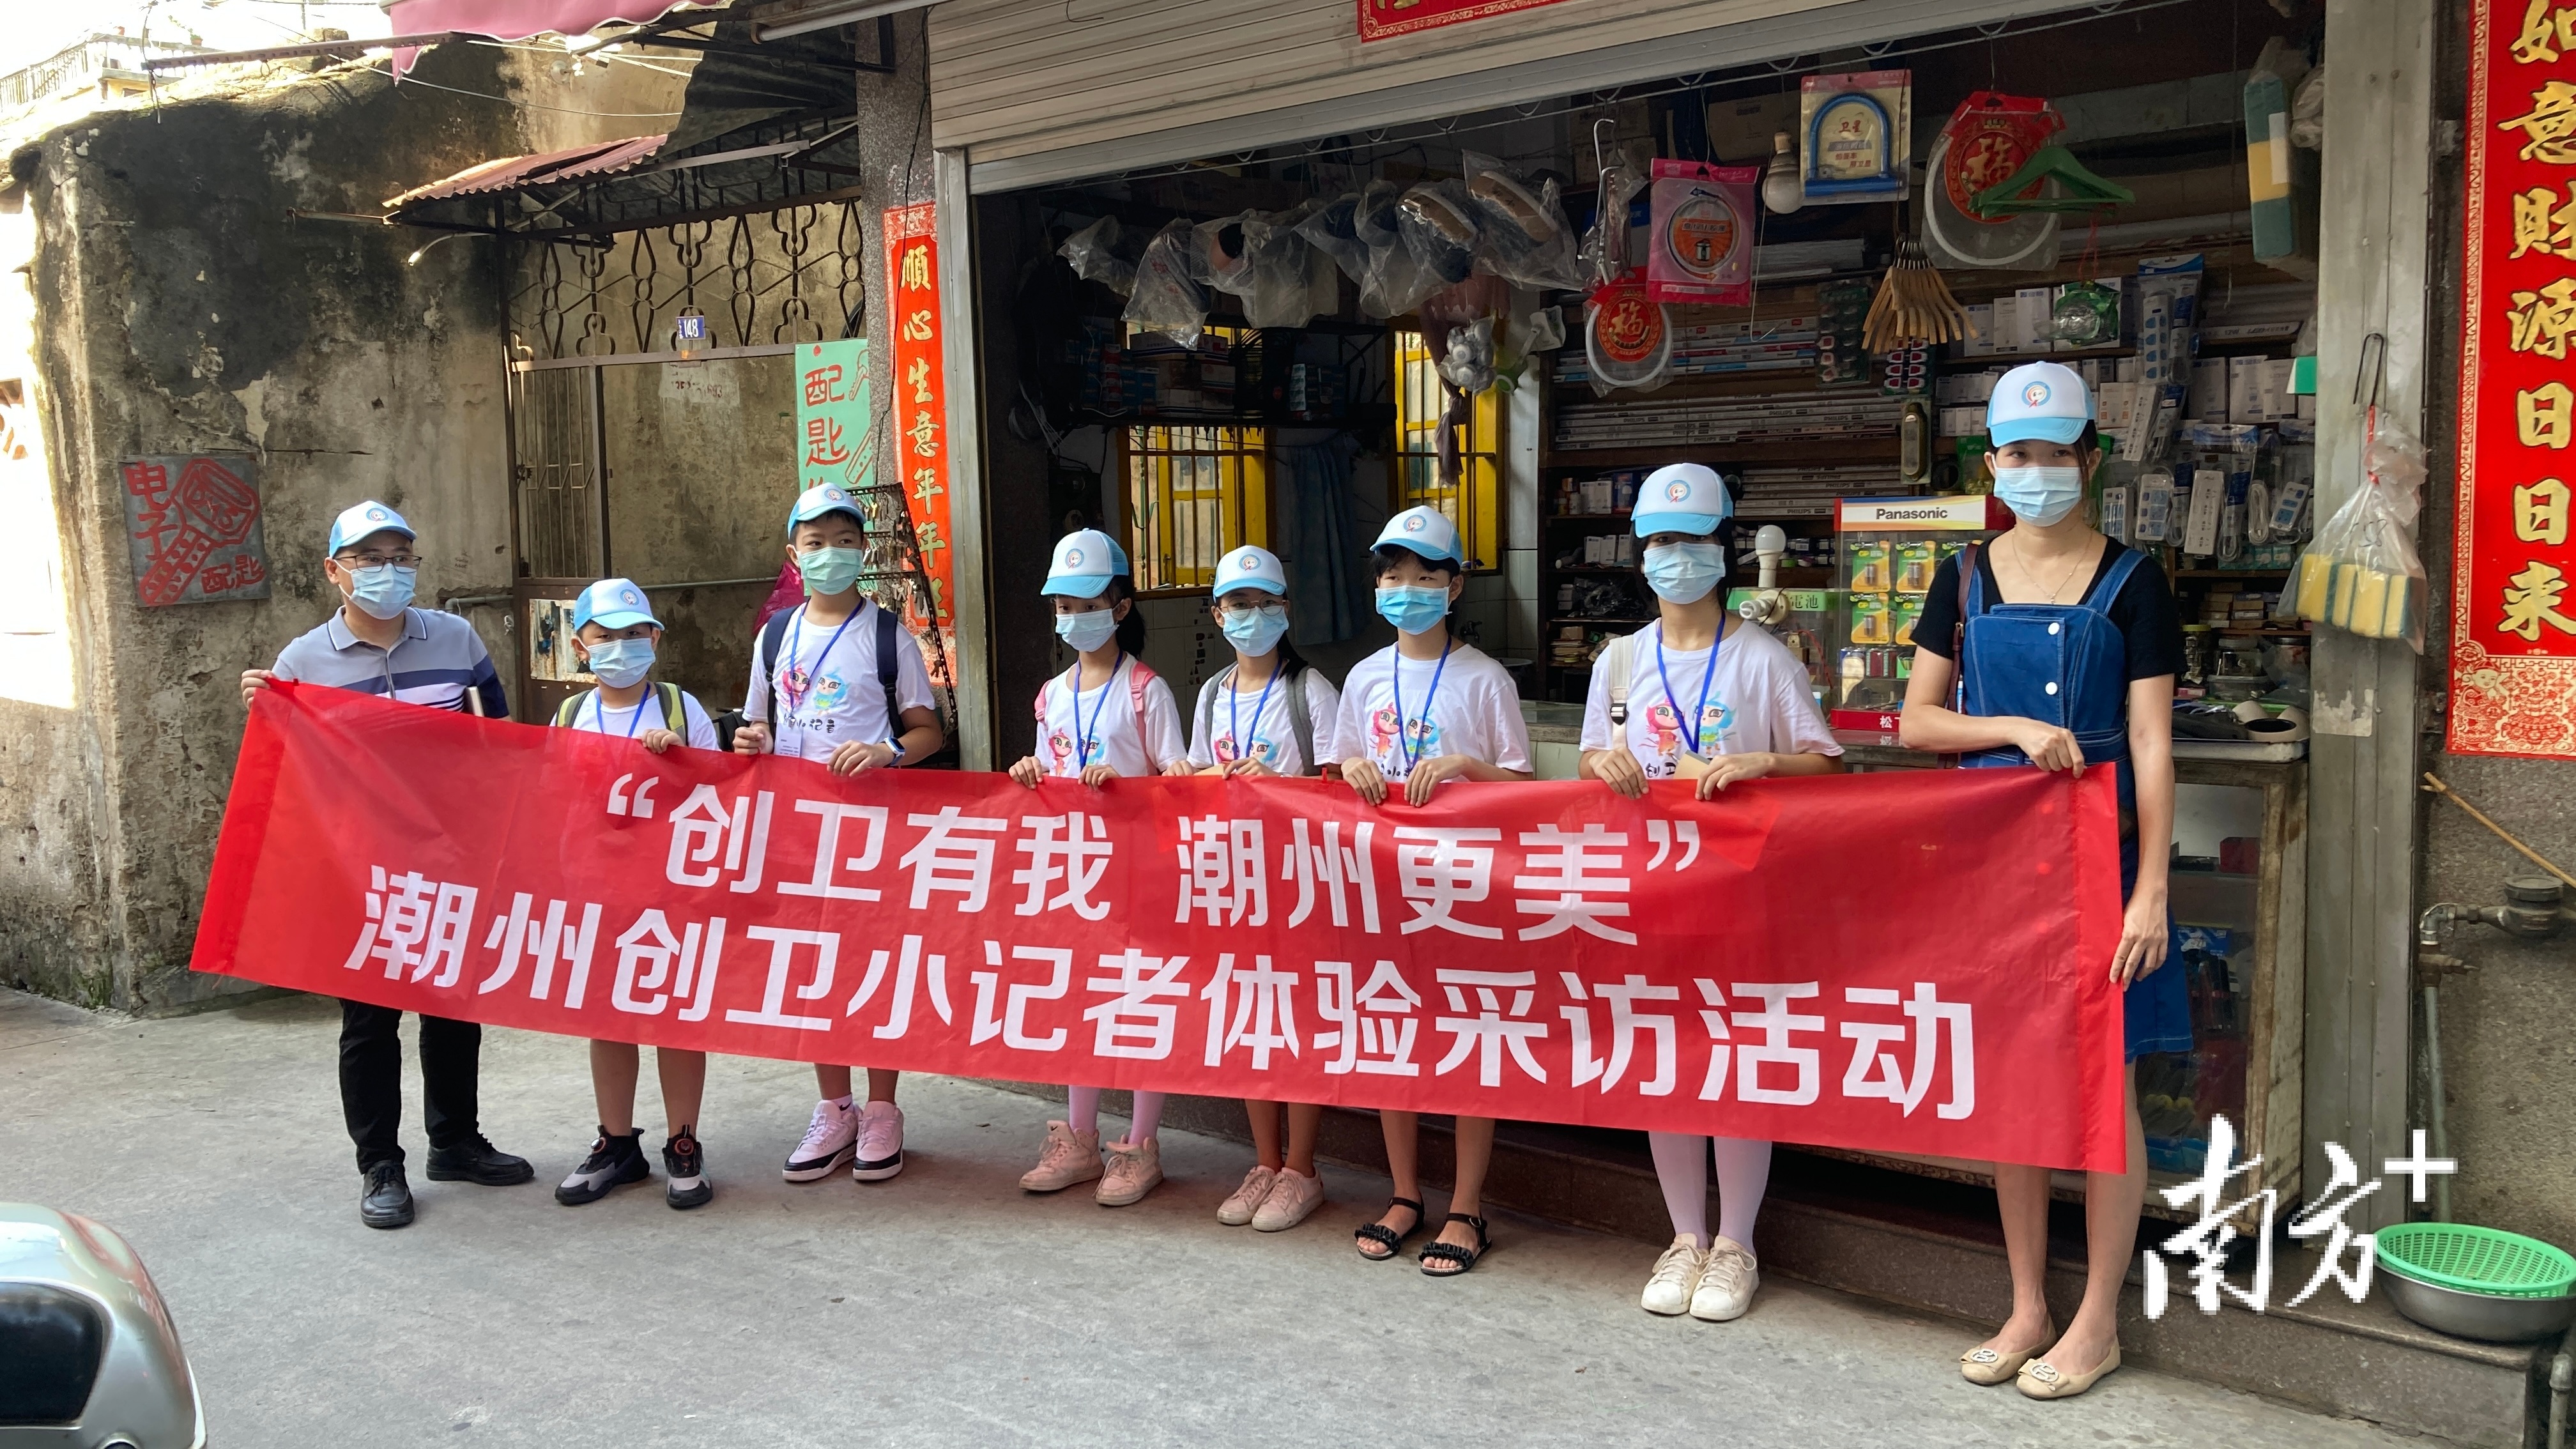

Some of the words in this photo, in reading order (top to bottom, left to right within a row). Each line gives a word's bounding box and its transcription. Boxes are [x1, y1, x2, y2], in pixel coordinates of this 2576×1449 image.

[684, 319, 699, 338] 148
[1611, 301, 1644, 336] 福
[804, 364, 850, 487] 配匙
[124, 461, 178, 561] 电子
[1875, 507, 1948, 520] Panasonic
[202, 554, 265, 594] 配匙
[1880, 715, 1901, 728] 松
[606, 772, 1113, 921] “创卫有我
[1174, 814, 1701, 946] 潮州更美”
[343, 864, 1975, 1120] 潮州创卫小记者体验采访活动
